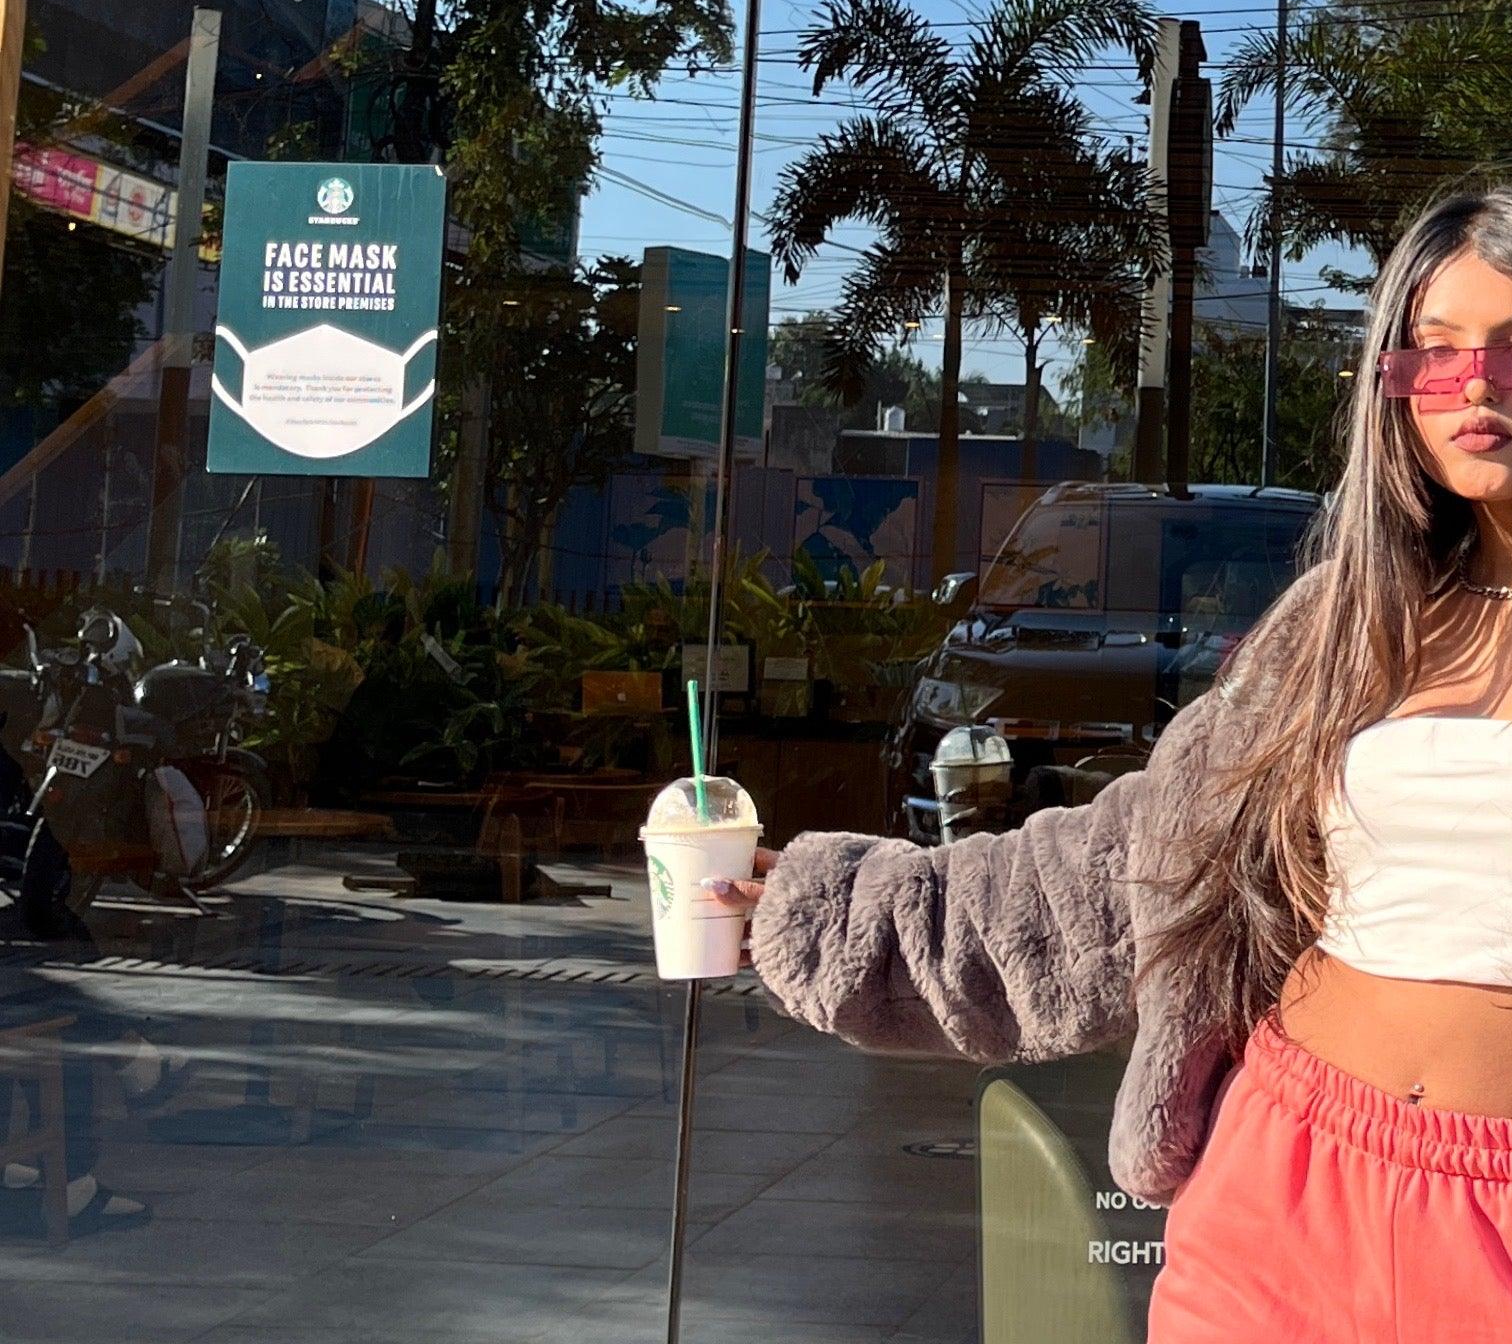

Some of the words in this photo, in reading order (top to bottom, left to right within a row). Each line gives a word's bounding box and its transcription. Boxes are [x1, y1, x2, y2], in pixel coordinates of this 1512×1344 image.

[265, 243, 323, 268] FACE
[328, 244, 397, 269] MASK
[264, 271, 284, 292] IS
[289, 271, 396, 294] ESSENTIAL
[262, 296, 276, 308] IN
[278, 296, 299, 309] THE
[300, 297, 336, 309] STORE
[338, 297, 395, 311] PREMISES
[1096, 1191, 1127, 1209] NO
[1088, 1240, 1165, 1265] RIGHT
